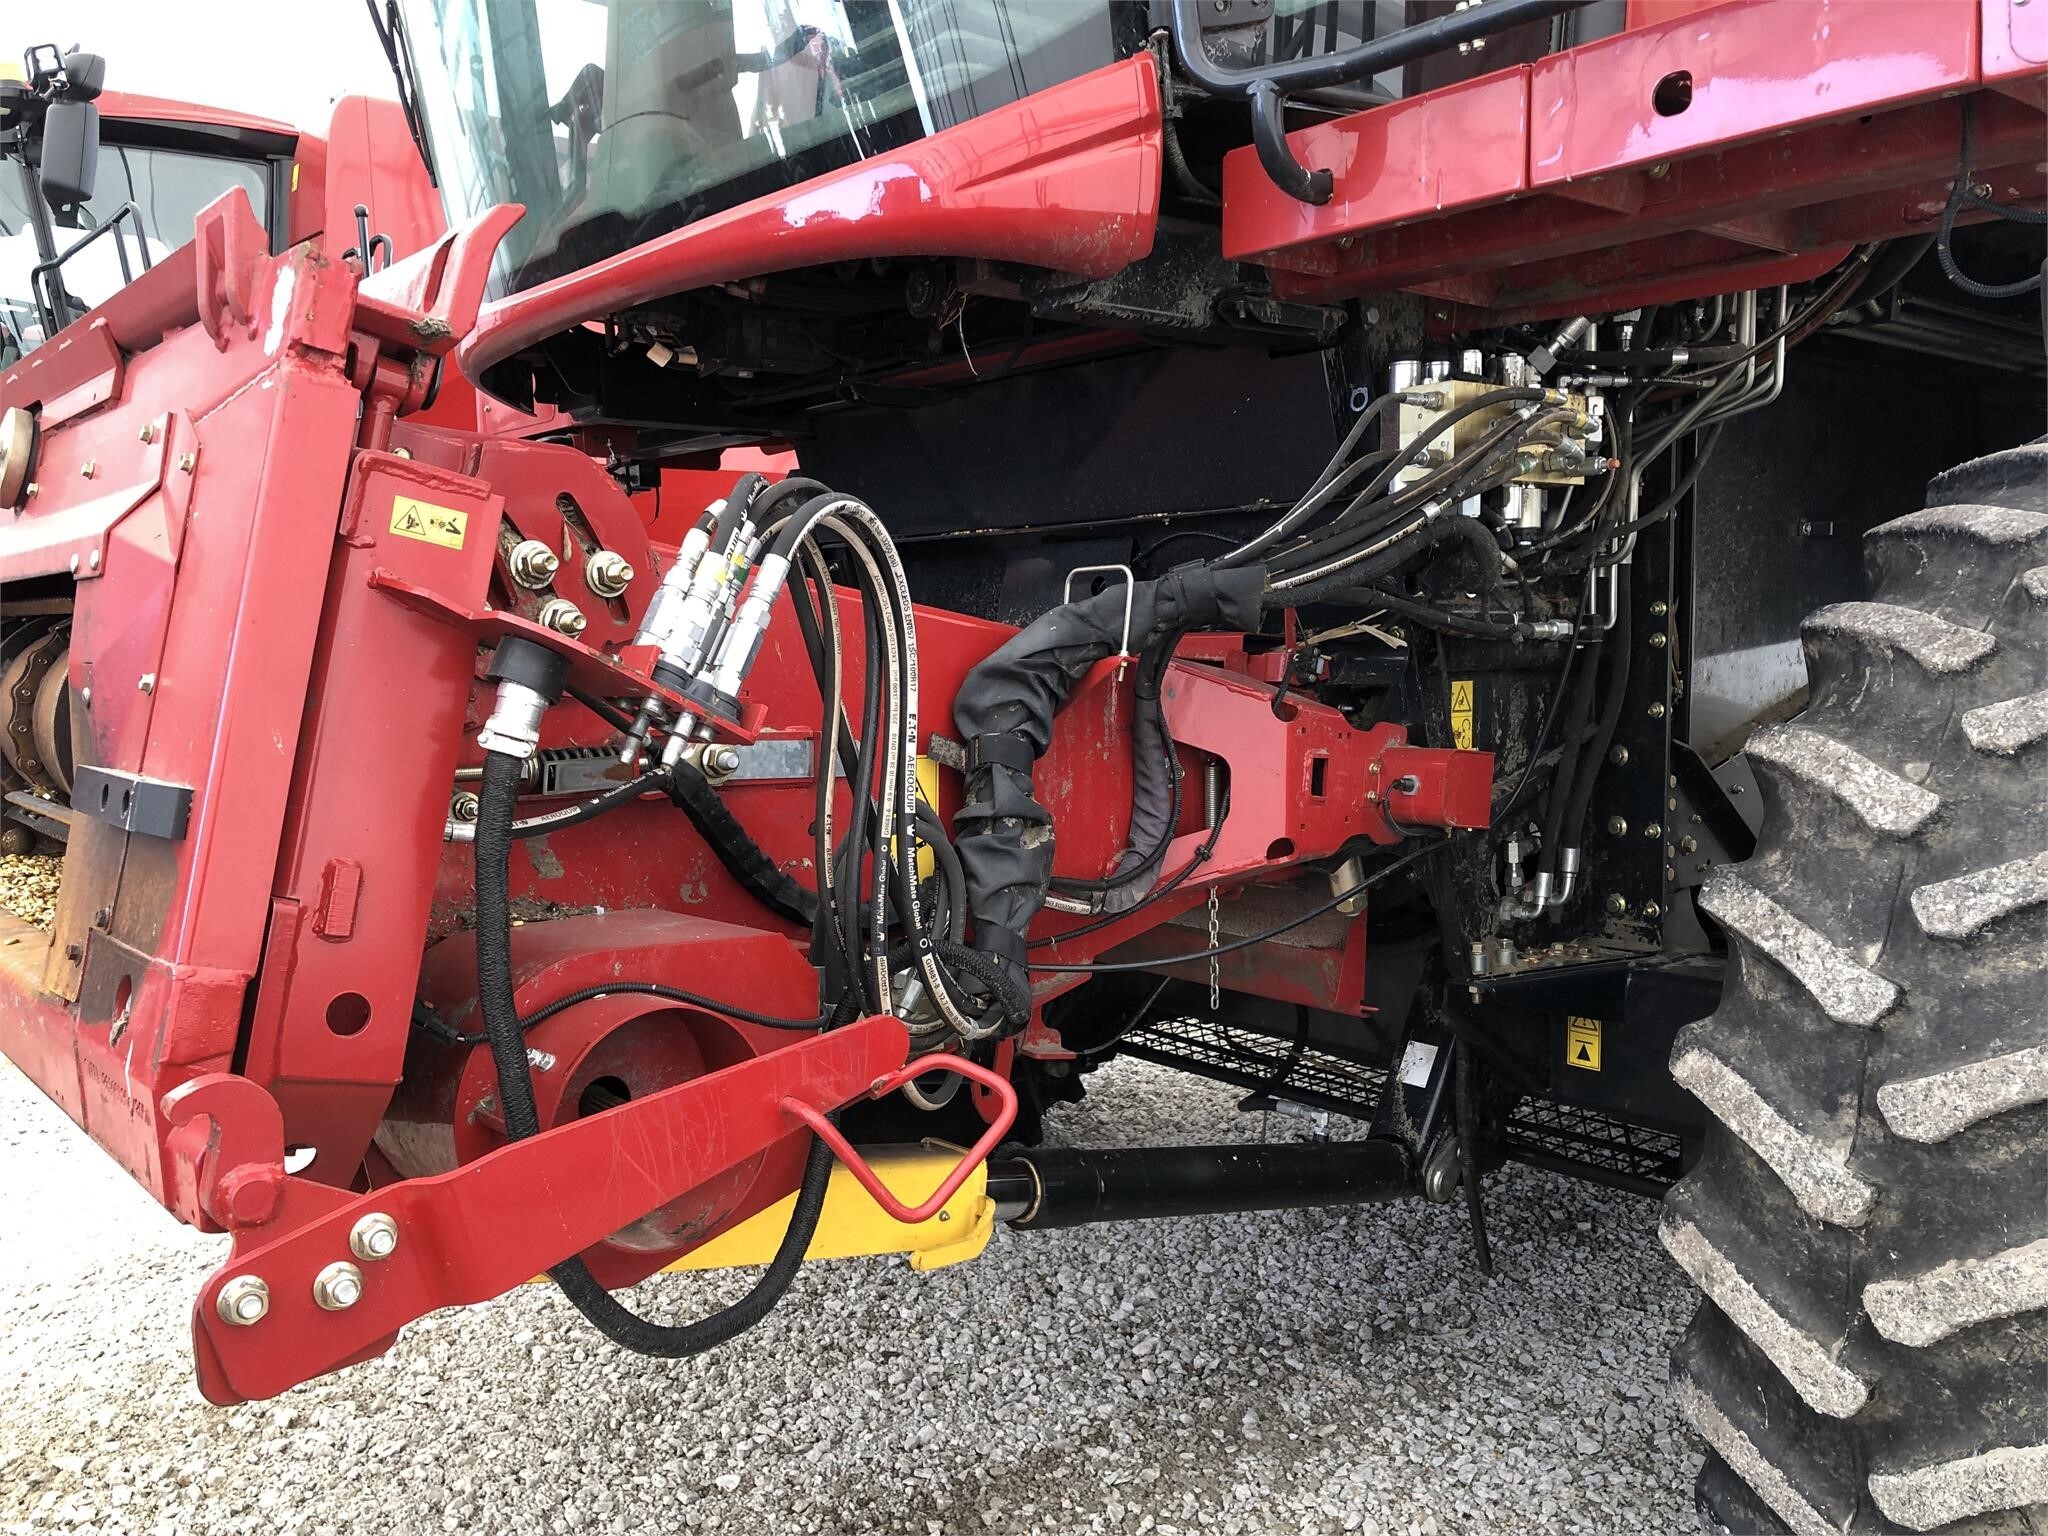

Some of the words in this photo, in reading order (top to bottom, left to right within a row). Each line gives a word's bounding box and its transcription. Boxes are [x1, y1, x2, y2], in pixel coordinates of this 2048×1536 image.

[895, 575, 912, 613] EXCEEDS
[905, 755, 916, 812] AEROQUIP
[540, 807, 579, 822] AEROQUIP
[826, 847, 834, 887] AEROQUIP
[878, 859, 887, 883] Global
[906, 847, 919, 900] MatchMate
[877, 884, 886, 924] MatchMate
[911, 900, 923, 930] Global
[879, 957, 889, 997] AEROQUIP
[925, 958, 941, 990] GH681-8
